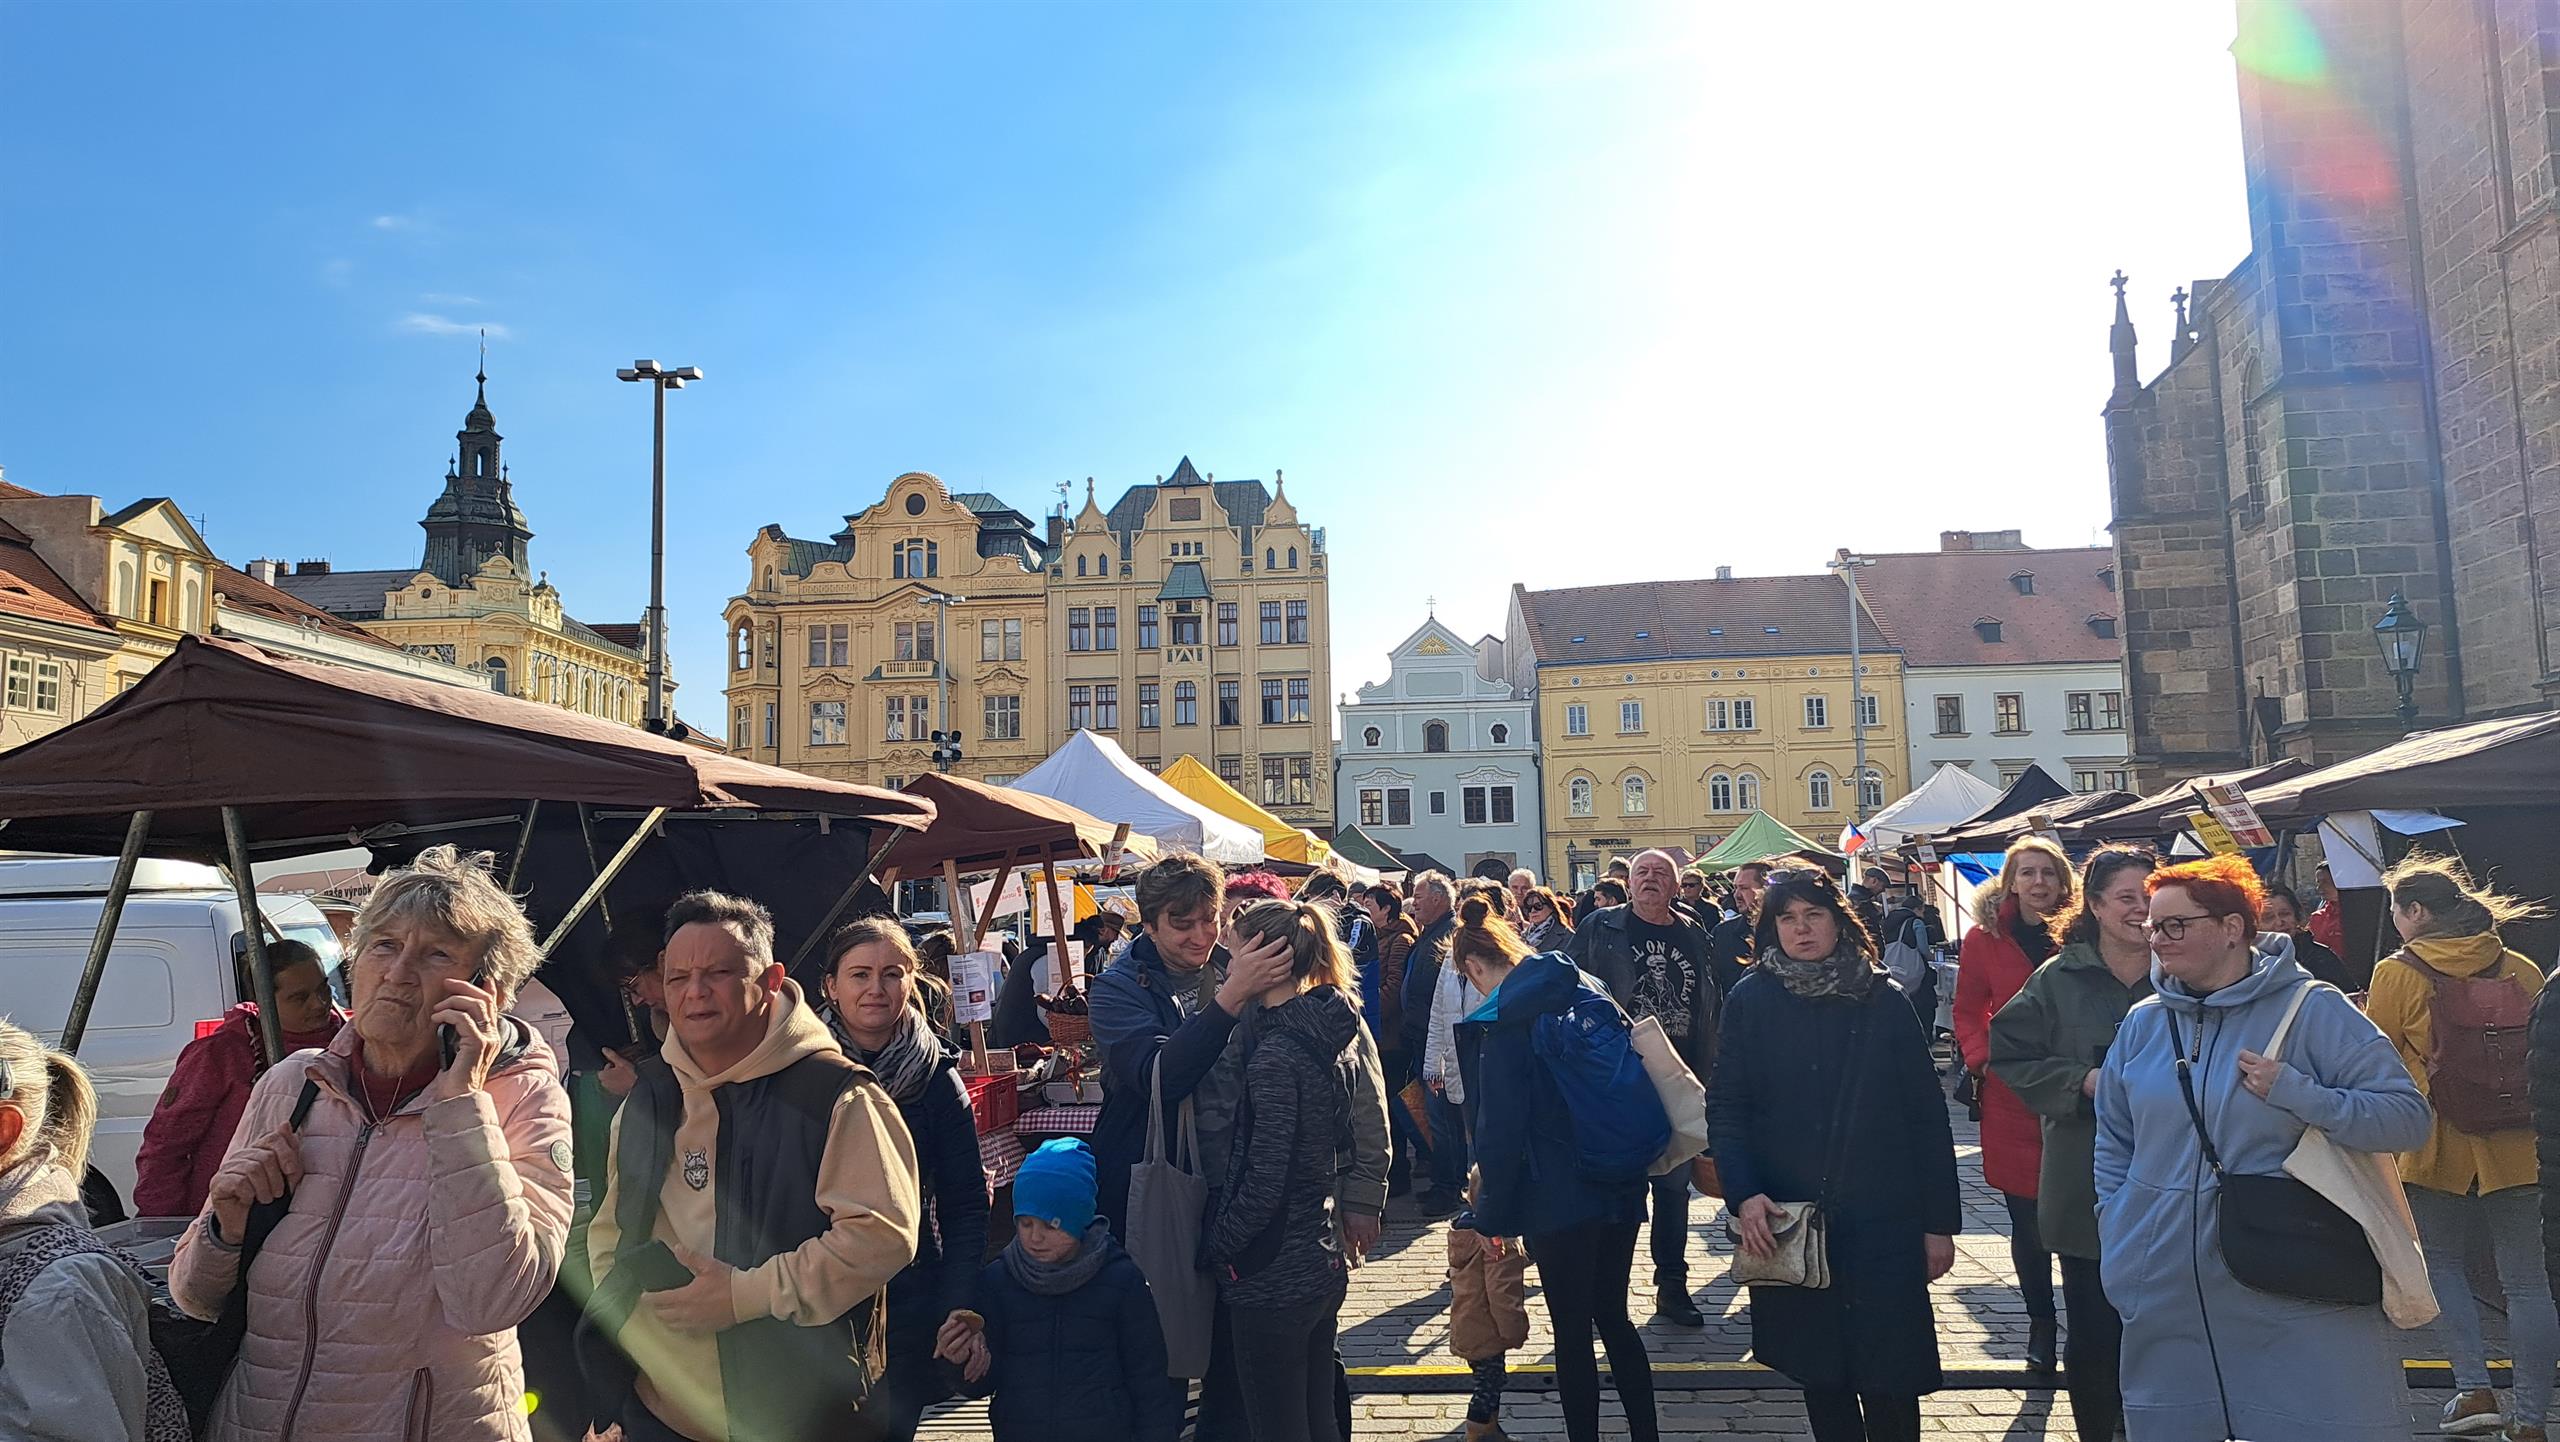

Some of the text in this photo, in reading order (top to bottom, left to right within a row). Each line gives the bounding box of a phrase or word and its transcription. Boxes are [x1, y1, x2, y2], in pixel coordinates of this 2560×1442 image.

[344, 884, 374, 900] výrobk
[1646, 940, 1666, 955] ON
[1670, 947, 1696, 1005] WHEELS
